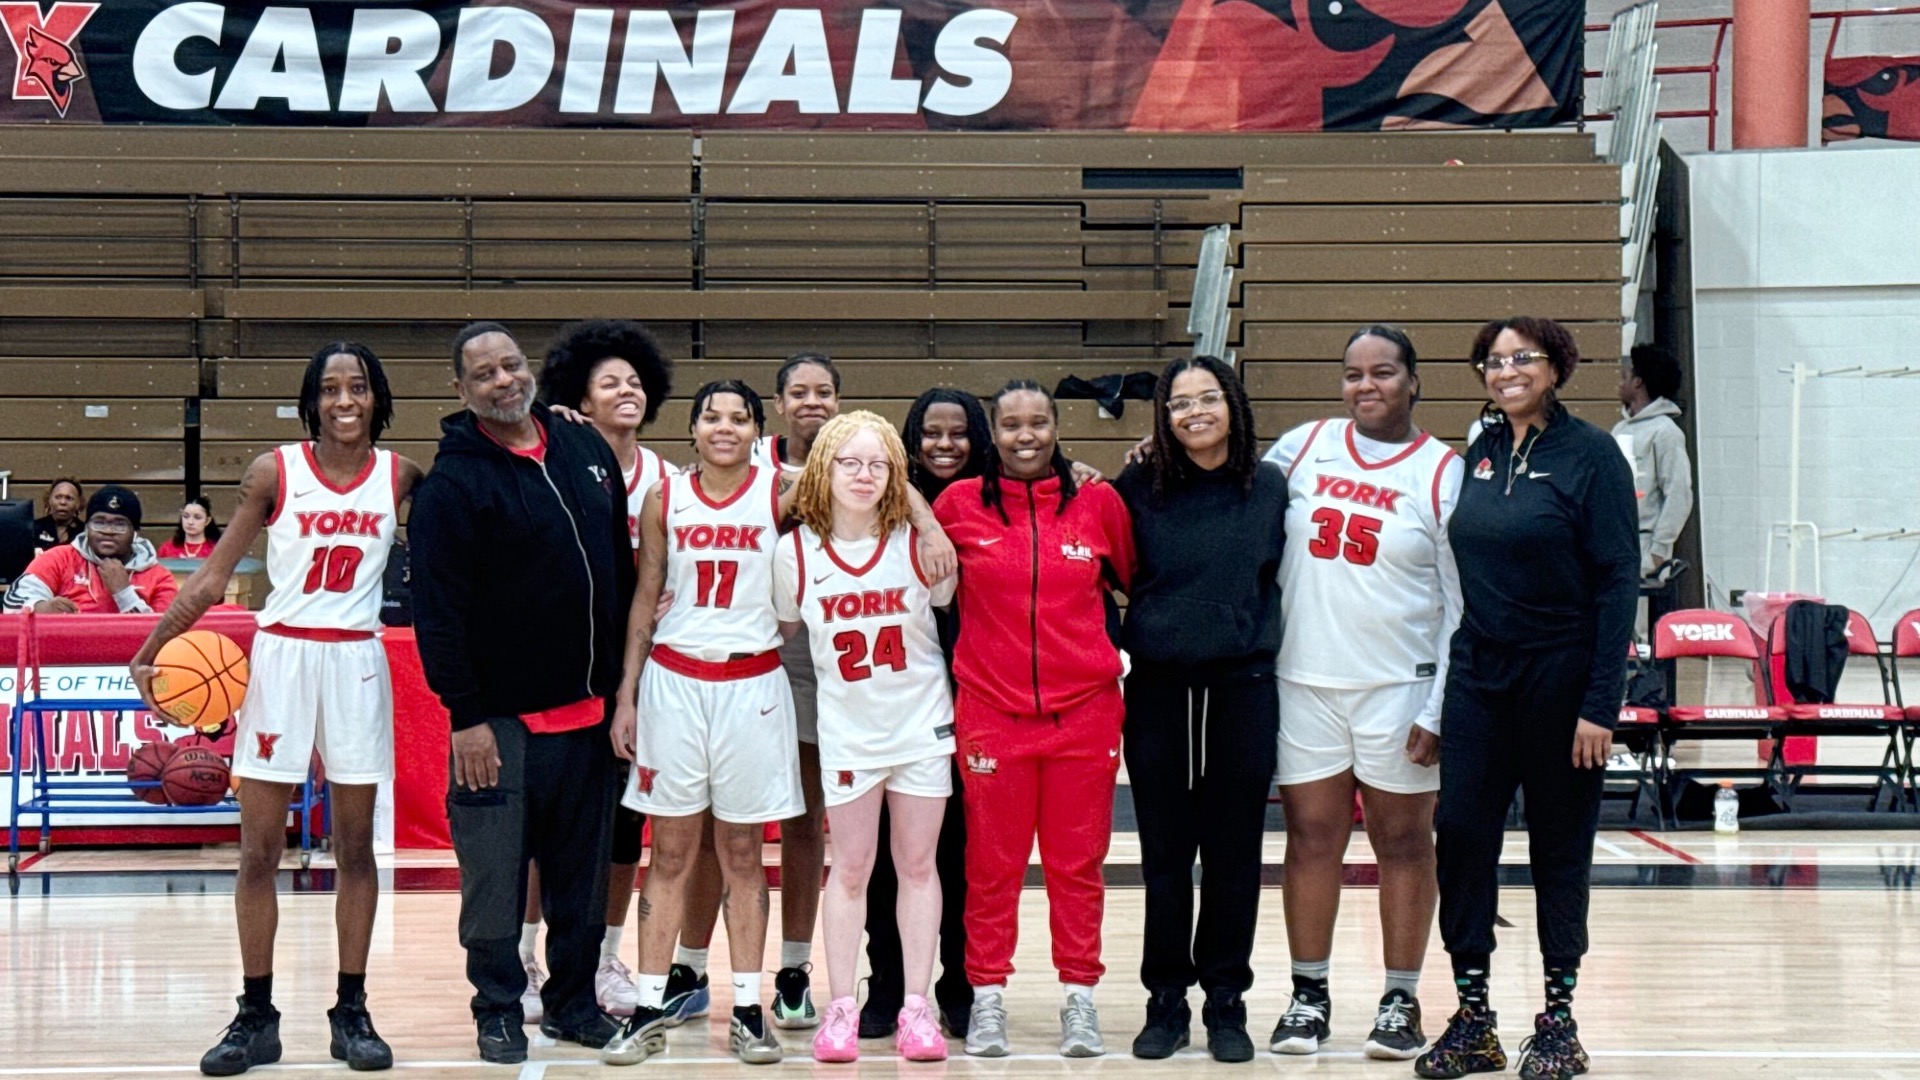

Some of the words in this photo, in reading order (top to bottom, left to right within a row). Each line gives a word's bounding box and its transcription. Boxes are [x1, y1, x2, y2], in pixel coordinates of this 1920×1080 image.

[133, 2, 1018, 116] CARDINALS
[1311, 473, 1404, 515] YORK
[293, 508, 388, 539] YORK
[673, 523, 767, 552] YORK
[1309, 507, 1383, 567] 35
[302, 545, 364, 594] 10
[693, 560, 738, 609] 11
[817, 586, 911, 623] YORK
[1669, 623, 1735, 641] YORK
[832, 624, 907, 682] 24
[57, 676, 88, 691] OF
[95, 676, 136, 690] THE
[1704, 708, 1769, 719] CARDINALS
[1819, 708, 1885, 719] CARDINALS
